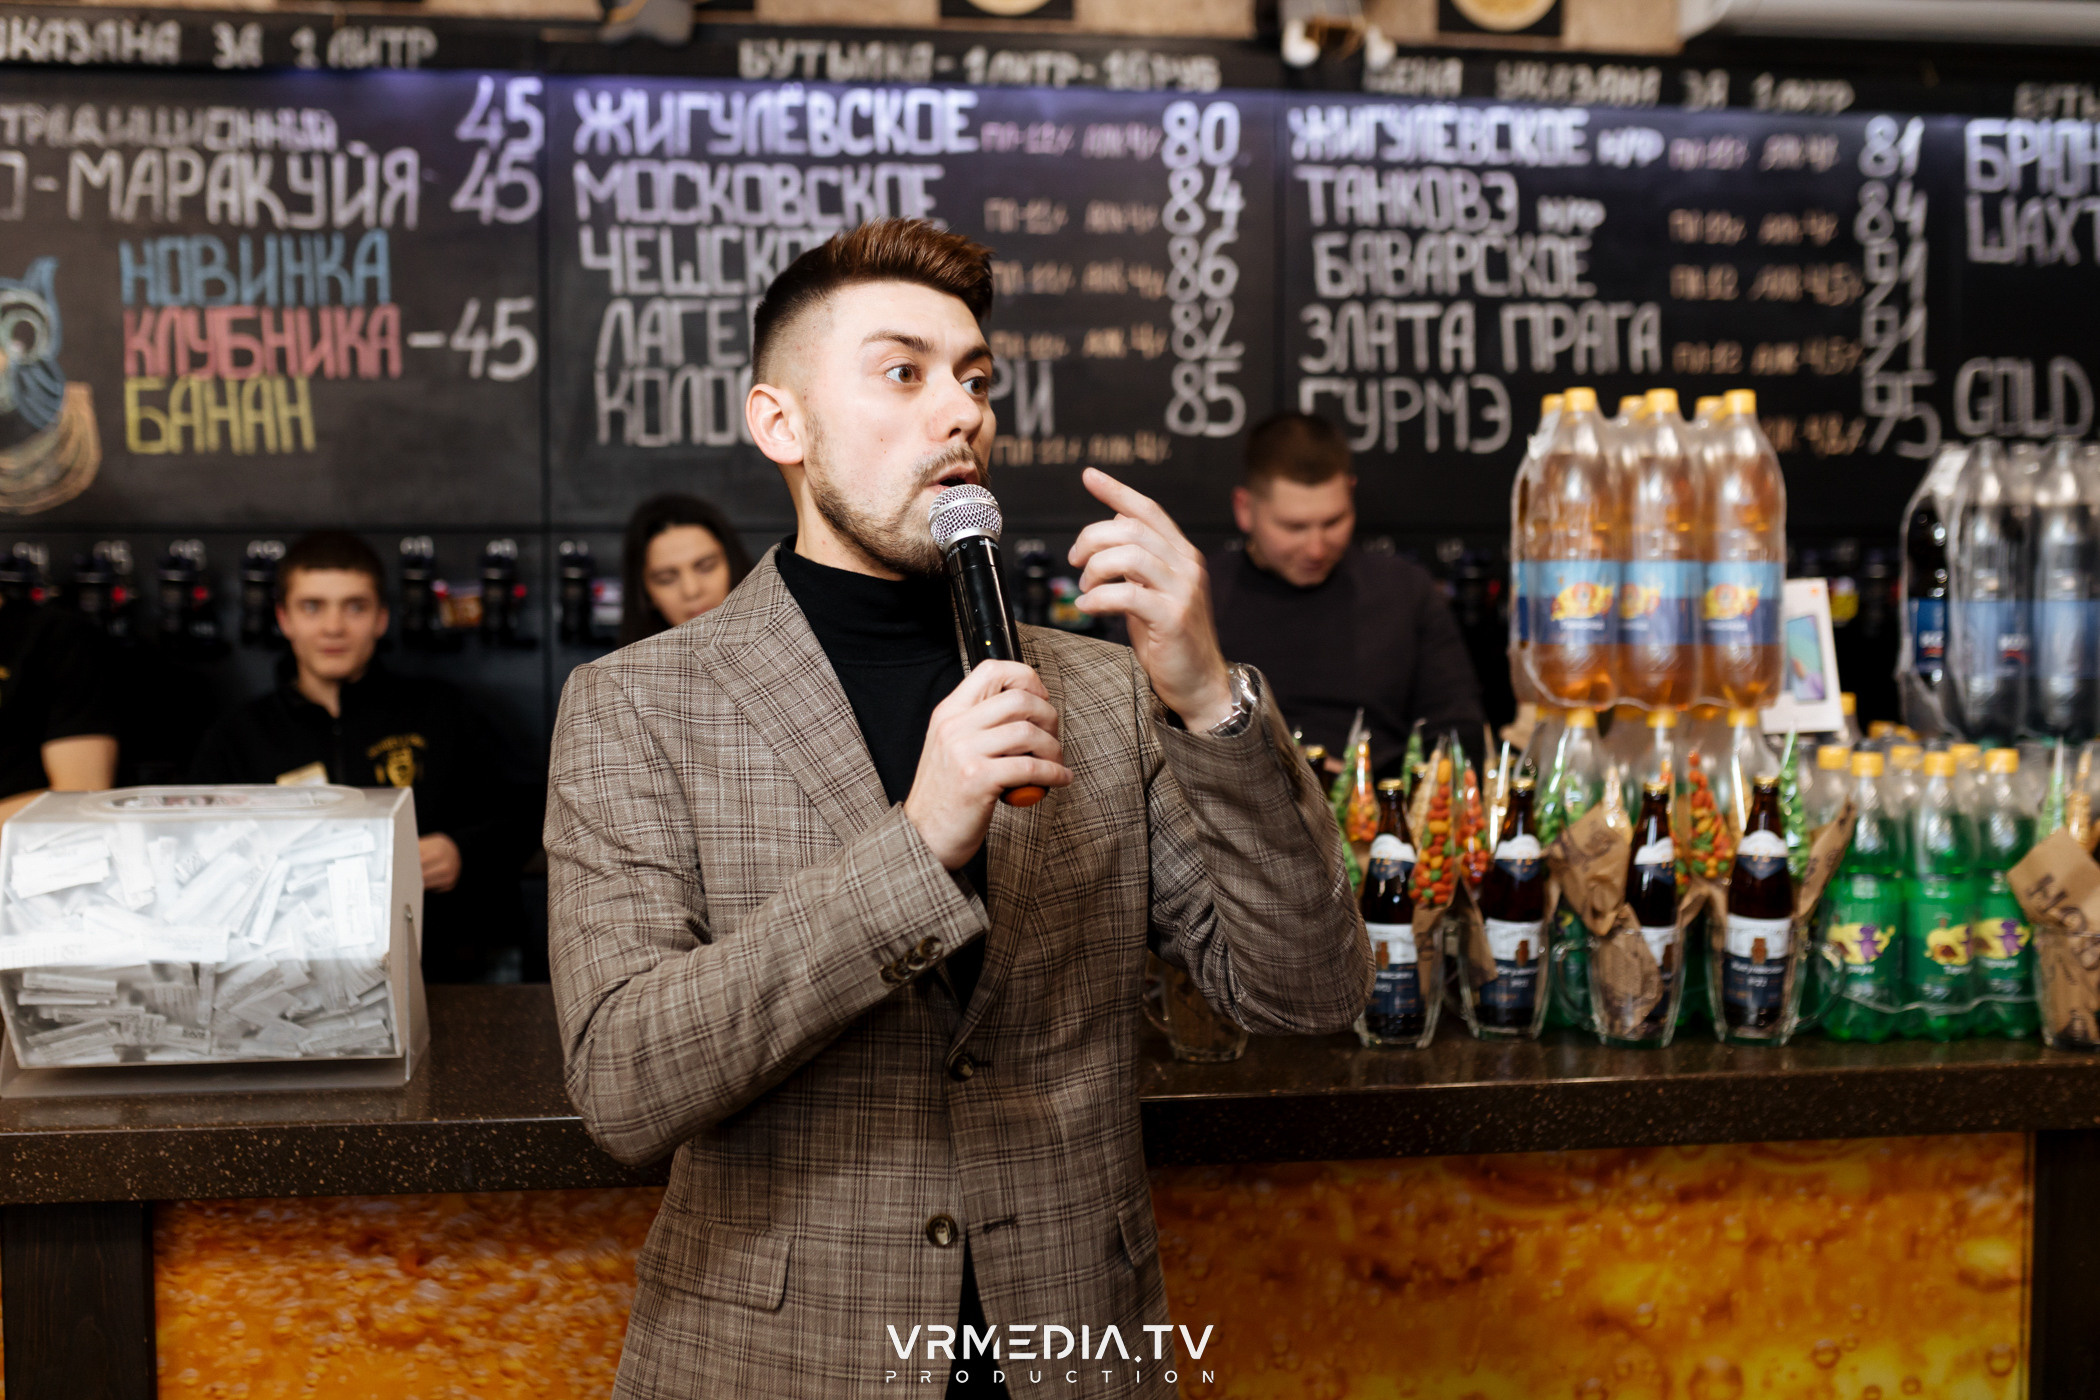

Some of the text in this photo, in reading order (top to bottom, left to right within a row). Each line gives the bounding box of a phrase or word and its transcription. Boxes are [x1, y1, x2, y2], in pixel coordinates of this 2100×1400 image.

[0, 16, 181, 65] КАЗАНА
[212, 22, 263, 67] ЗА
[456, 75, 544, 153] 45
[573, 83, 980, 156] ЖИГУЛЁВСКОЕ
[1161, 100, 1240, 169] 80
[1858, 114, 1925, 177] 81
[451, 147, 542, 223] 45
[573, 158, 947, 227] МОСКОВСКОЕ
[1162, 167, 1246, 238] 84
[1294, 164, 1520, 234] ТАНКОВЭ
[1854, 179, 1928, 243] 84
[120, 230, 391, 307] НОВИНКА
[1166, 230, 1240, 301] 86
[1312, 230, 1597, 298] БАВАРСКОЕ
[123, 303, 402, 379] КЛУБНИКА
[595, 297, 764, 367] ЛАГЕ
[1170, 298, 1246, 361] 82
[1299, 301, 1476, 374] ЗЛАТА
[1500, 301, 1663, 374] ПРАГА
[124, 374, 316, 454] БАНАН
[1165, 360, 1246, 437] 85
[1299, 374, 1512, 454] ГУРМЭ
[1954, 357, 2094, 437] GOLD
